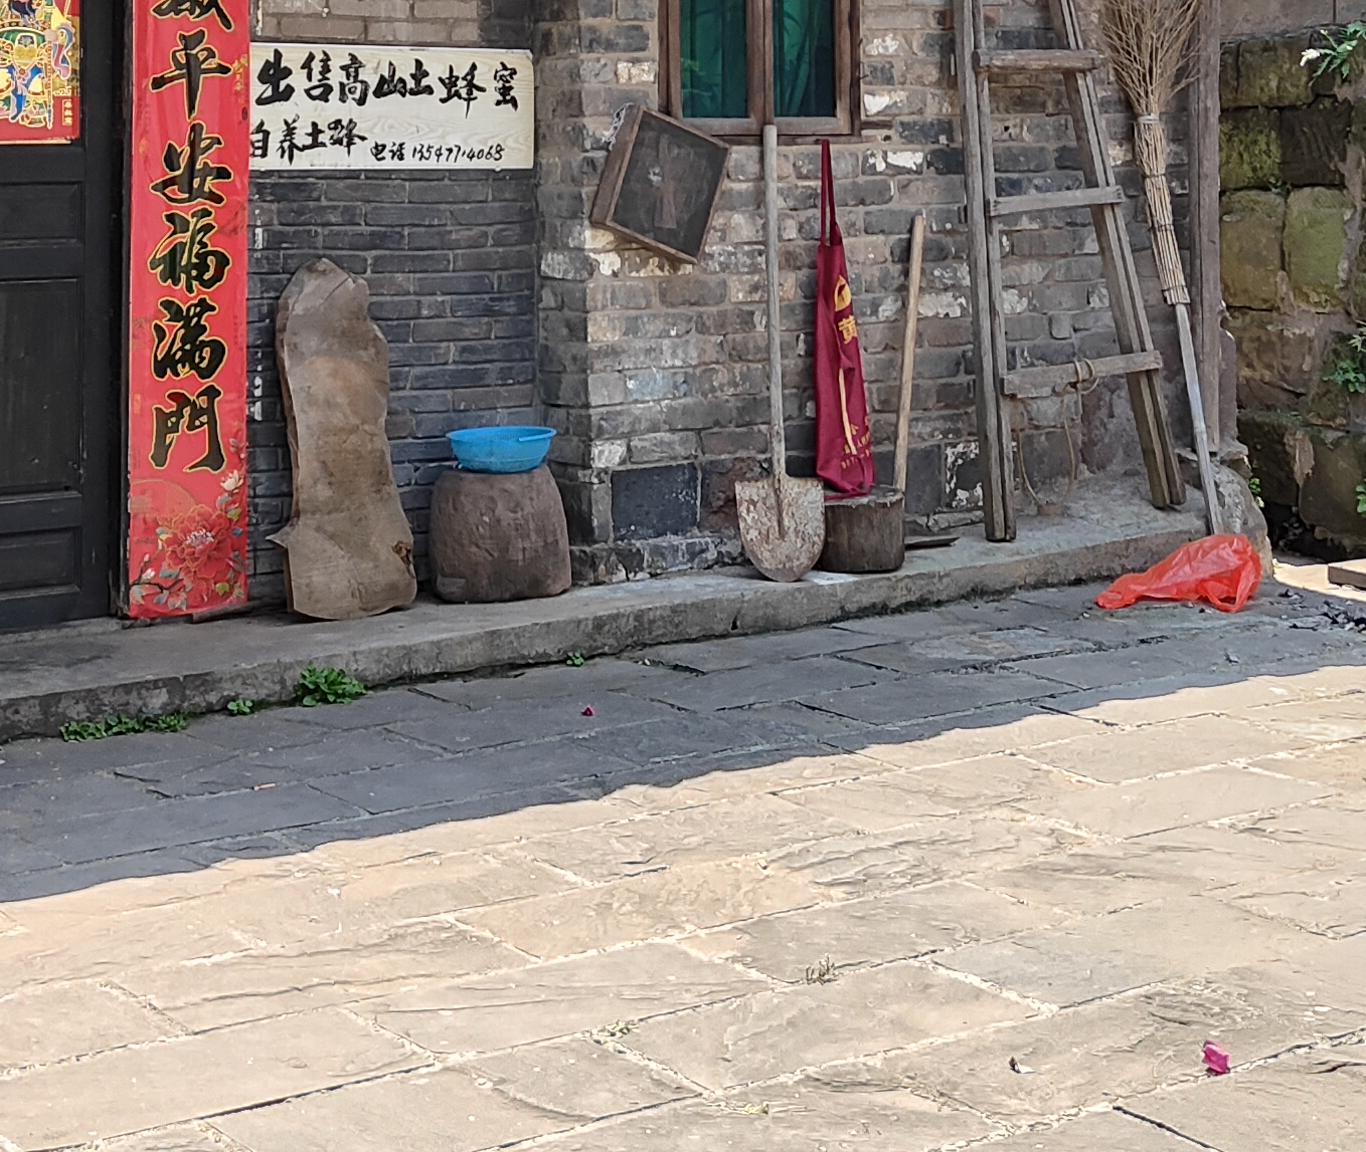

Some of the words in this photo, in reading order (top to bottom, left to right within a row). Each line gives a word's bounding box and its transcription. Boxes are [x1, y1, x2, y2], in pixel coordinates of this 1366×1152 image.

[255, 48, 519, 119] 出售高山土蜂蜜
[370, 141, 405, 162] 电话
